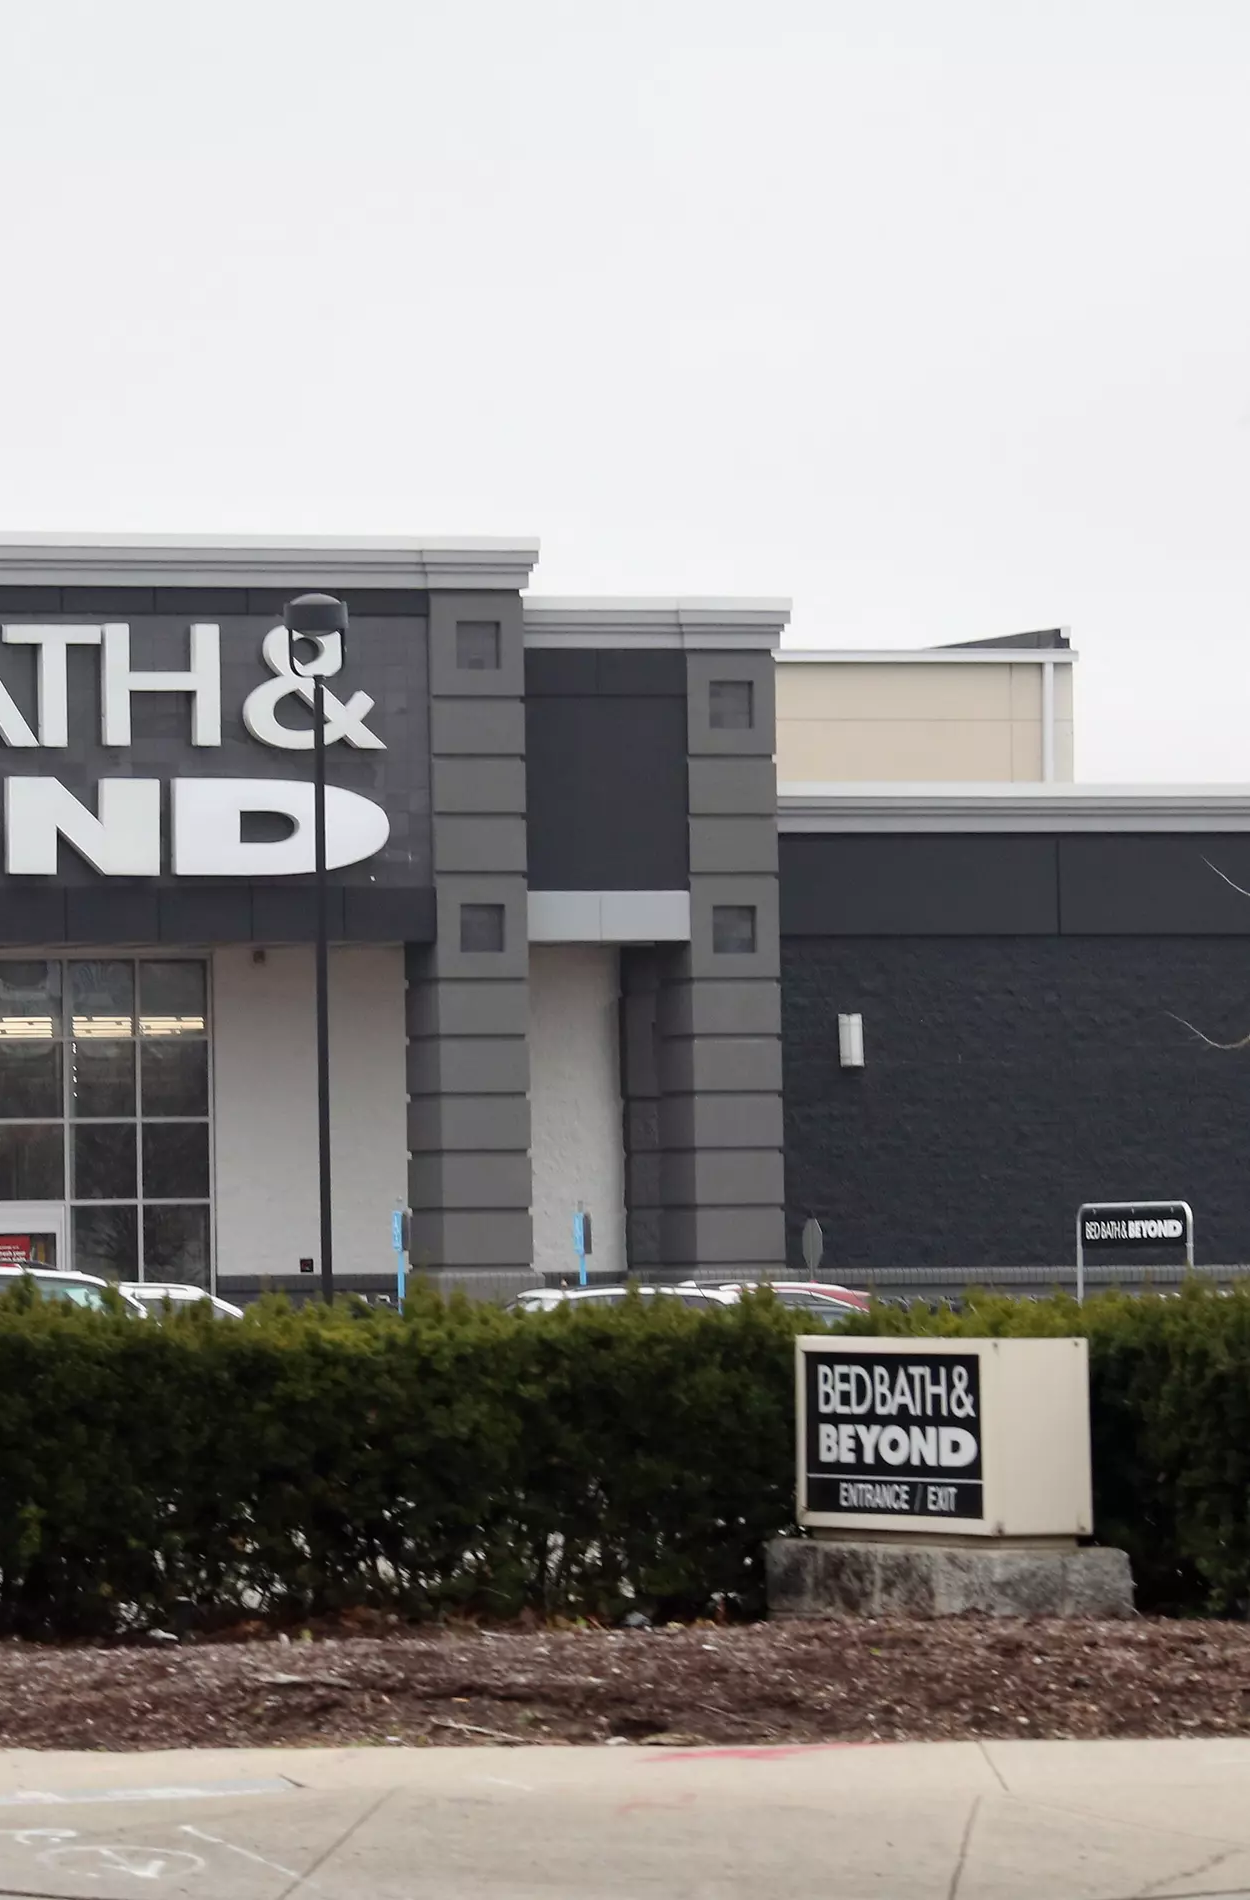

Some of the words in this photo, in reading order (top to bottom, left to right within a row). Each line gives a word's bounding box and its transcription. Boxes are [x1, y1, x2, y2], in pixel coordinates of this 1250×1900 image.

[243, 620, 388, 750] &
[1085, 1221, 1101, 1240] BED
[1101, 1221, 1121, 1240] BATH
[1128, 1219, 1183, 1239] BEYOND
[817, 1364, 873, 1415] BED
[873, 1365, 948, 1417] BATH
[950, 1365, 976, 1418] &
[818, 1423, 978, 1467] BEYOND
[839, 1482, 910, 1510] ENTRANCE
[927, 1486, 958, 1512] EXIT
